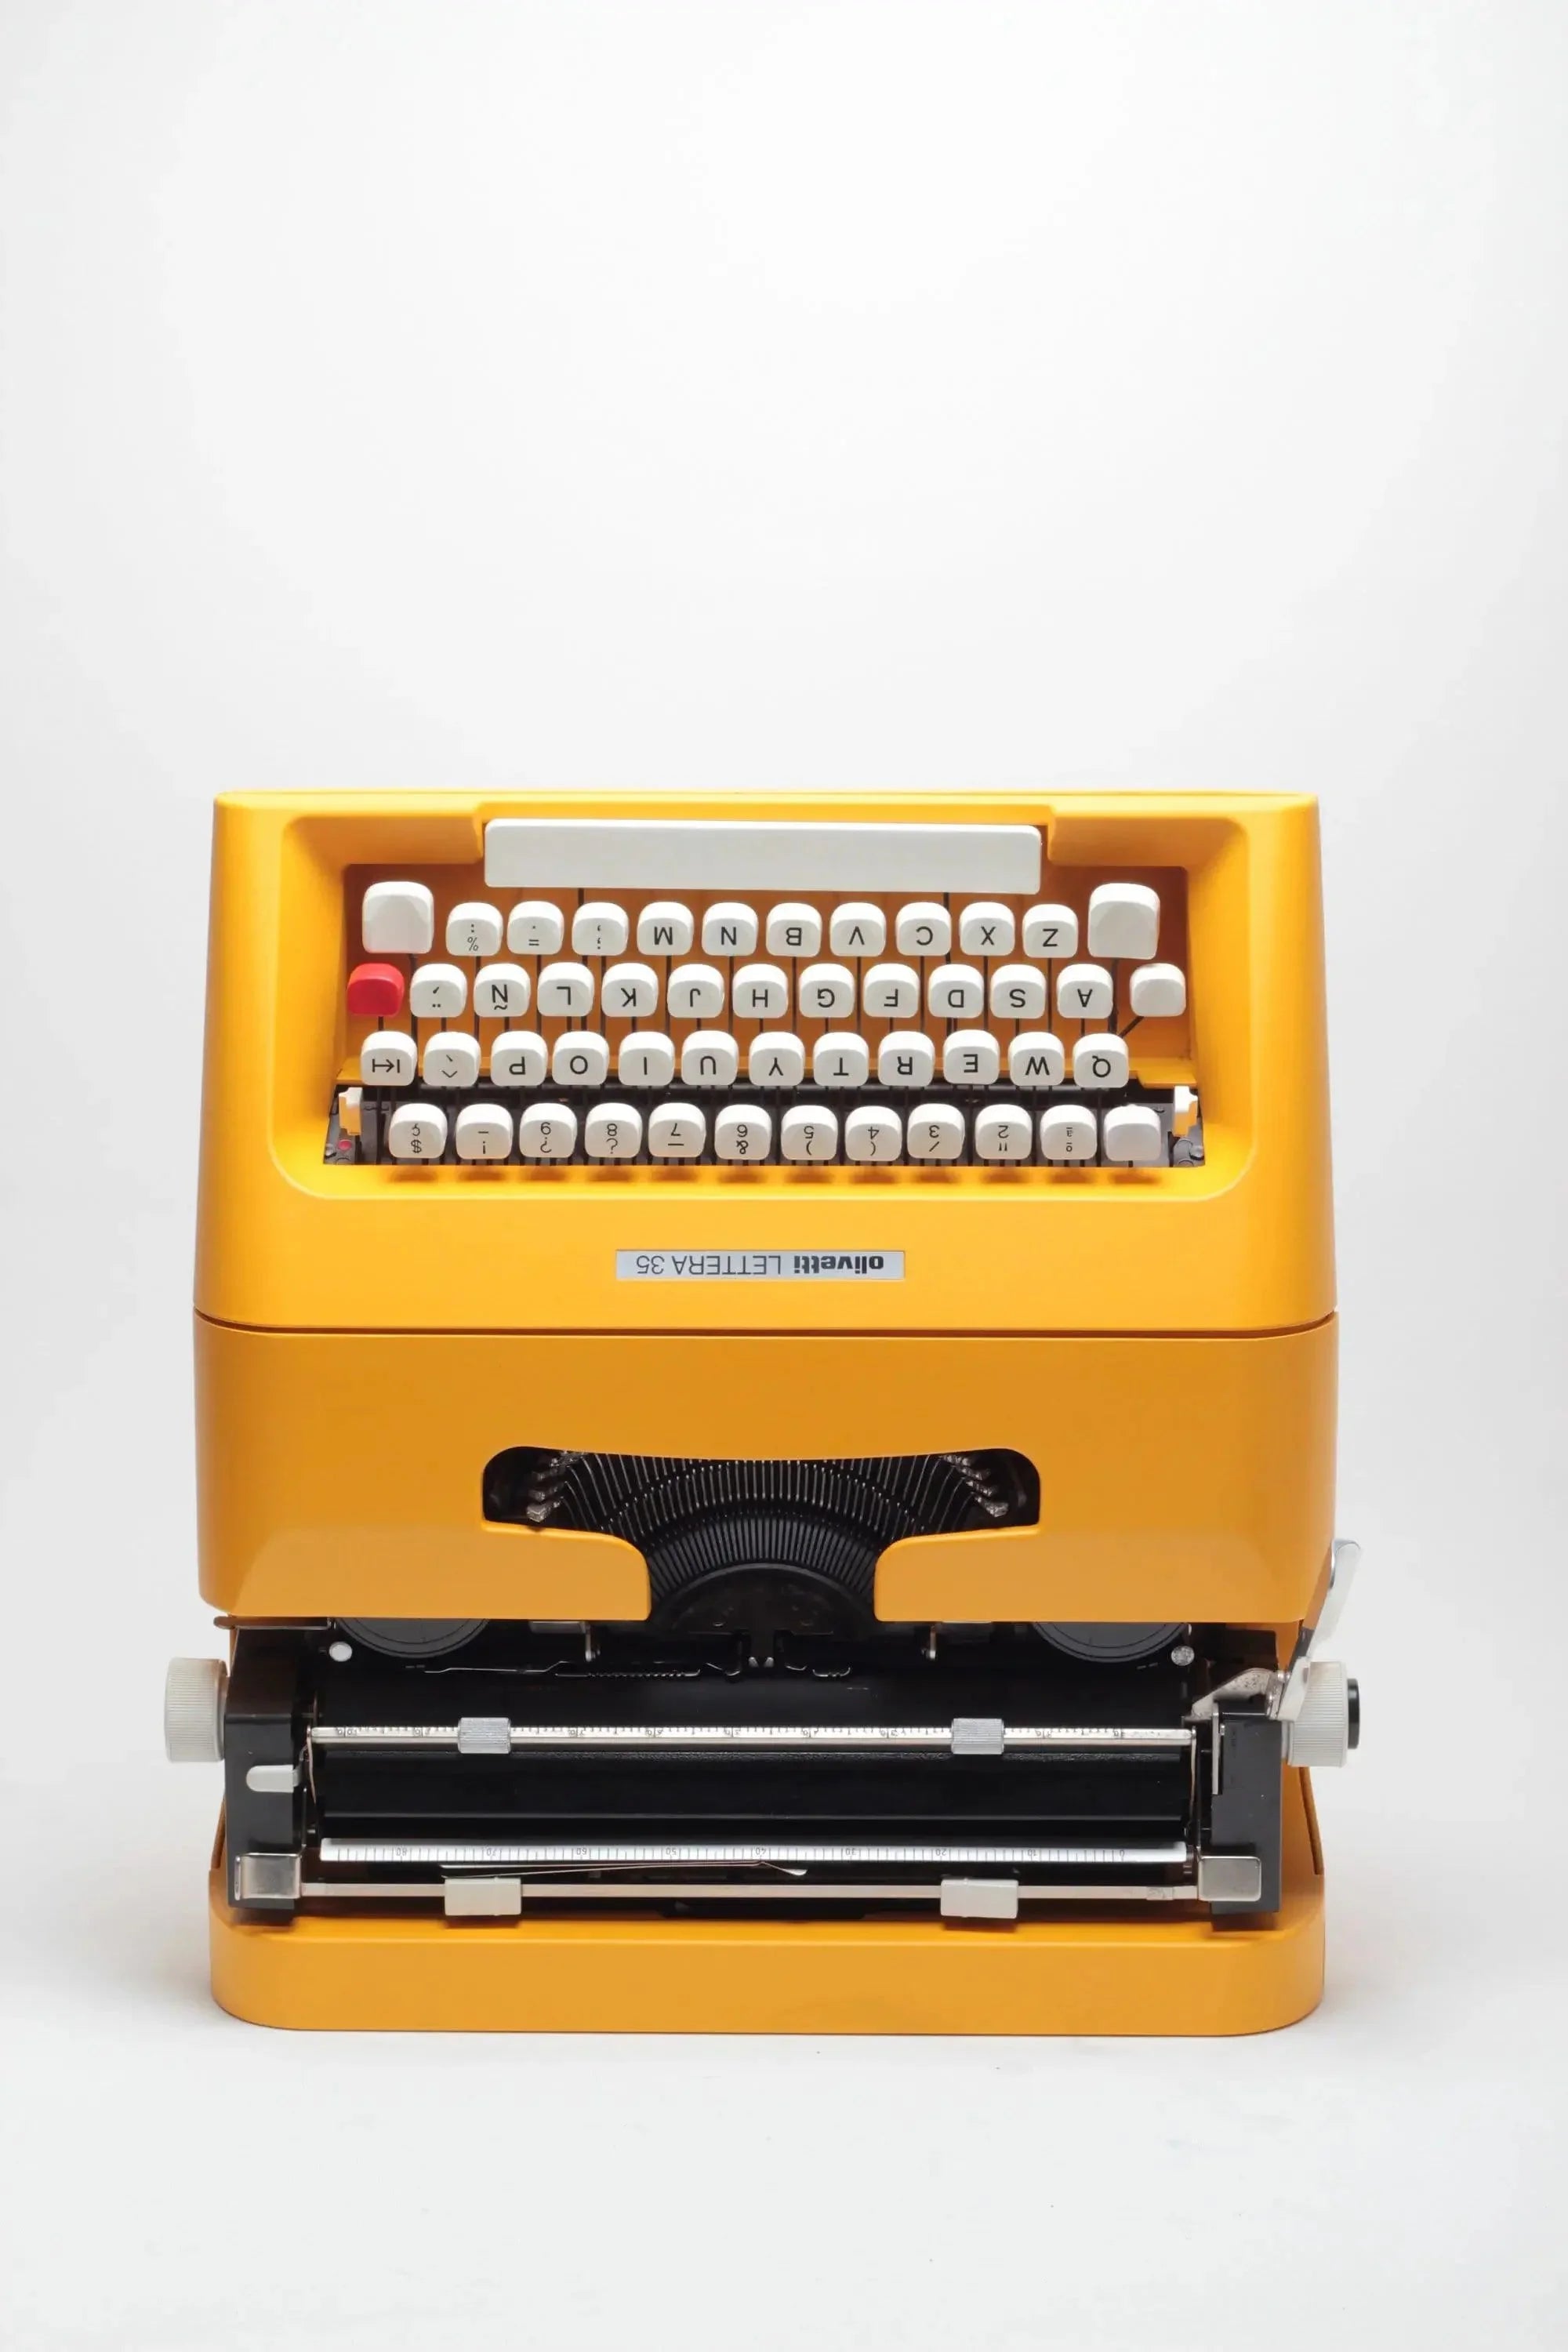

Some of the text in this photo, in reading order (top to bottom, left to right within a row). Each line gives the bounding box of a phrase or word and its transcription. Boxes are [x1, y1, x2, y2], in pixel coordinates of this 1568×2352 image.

[467, 936, 479, 952] %
[654, 926, 673, 946] M
[721, 926, 737, 946] N
[786, 927, 803, 946] B
[848, 926, 865, 946] V
[916, 926, 933, 946] C
[981, 926, 996, 946] X
[1043, 928, 1058, 947] Z
[492, 984, 508, 1010] Ñ
[557, 986, 571, 1005] L
[621, 988, 637, 1007] K
[690, 988, 701, 1007] J
[752, 989, 768, 1007] H
[817, 988, 835, 1008] G
[884, 989, 898, 1007] F
[948, 989, 964, 1008] D
[1009, 989, 1025, 1008] S
[1077, 989, 1093, 1007] A
[509, 1056, 526, 1075] P
[570, 1055, 588, 1075] O
[644, 1056, 648, 1075] I
[700, 1055, 717, 1075] U
[768, 1057, 783, 1076] Y
[833, 1057, 849, 1076] T
[897, 1056, 913, 1076] R
[963, 1054, 978, 1073] E
[1025, 1056, 1050, 1076] W
[1092, 1055, 1111, 1078] Q
[540, 1121, 552, 1135] 9
[605, 1123, 618, 1137] 8
[670, 1123, 681, 1137] 7
[736, 1123, 748, 1139] 6
[804, 1126, 815, 1139] 5
[866, 1126, 880, 1140] 4
[929, 1125, 940, 1138] 3
[997, 1125, 1010, 1138] 2
[410, 1139, 422, 1155] $
[736, 1140, 749, 1155] &
[637, 1255, 884, 1275] olivetti LETTERA 35
